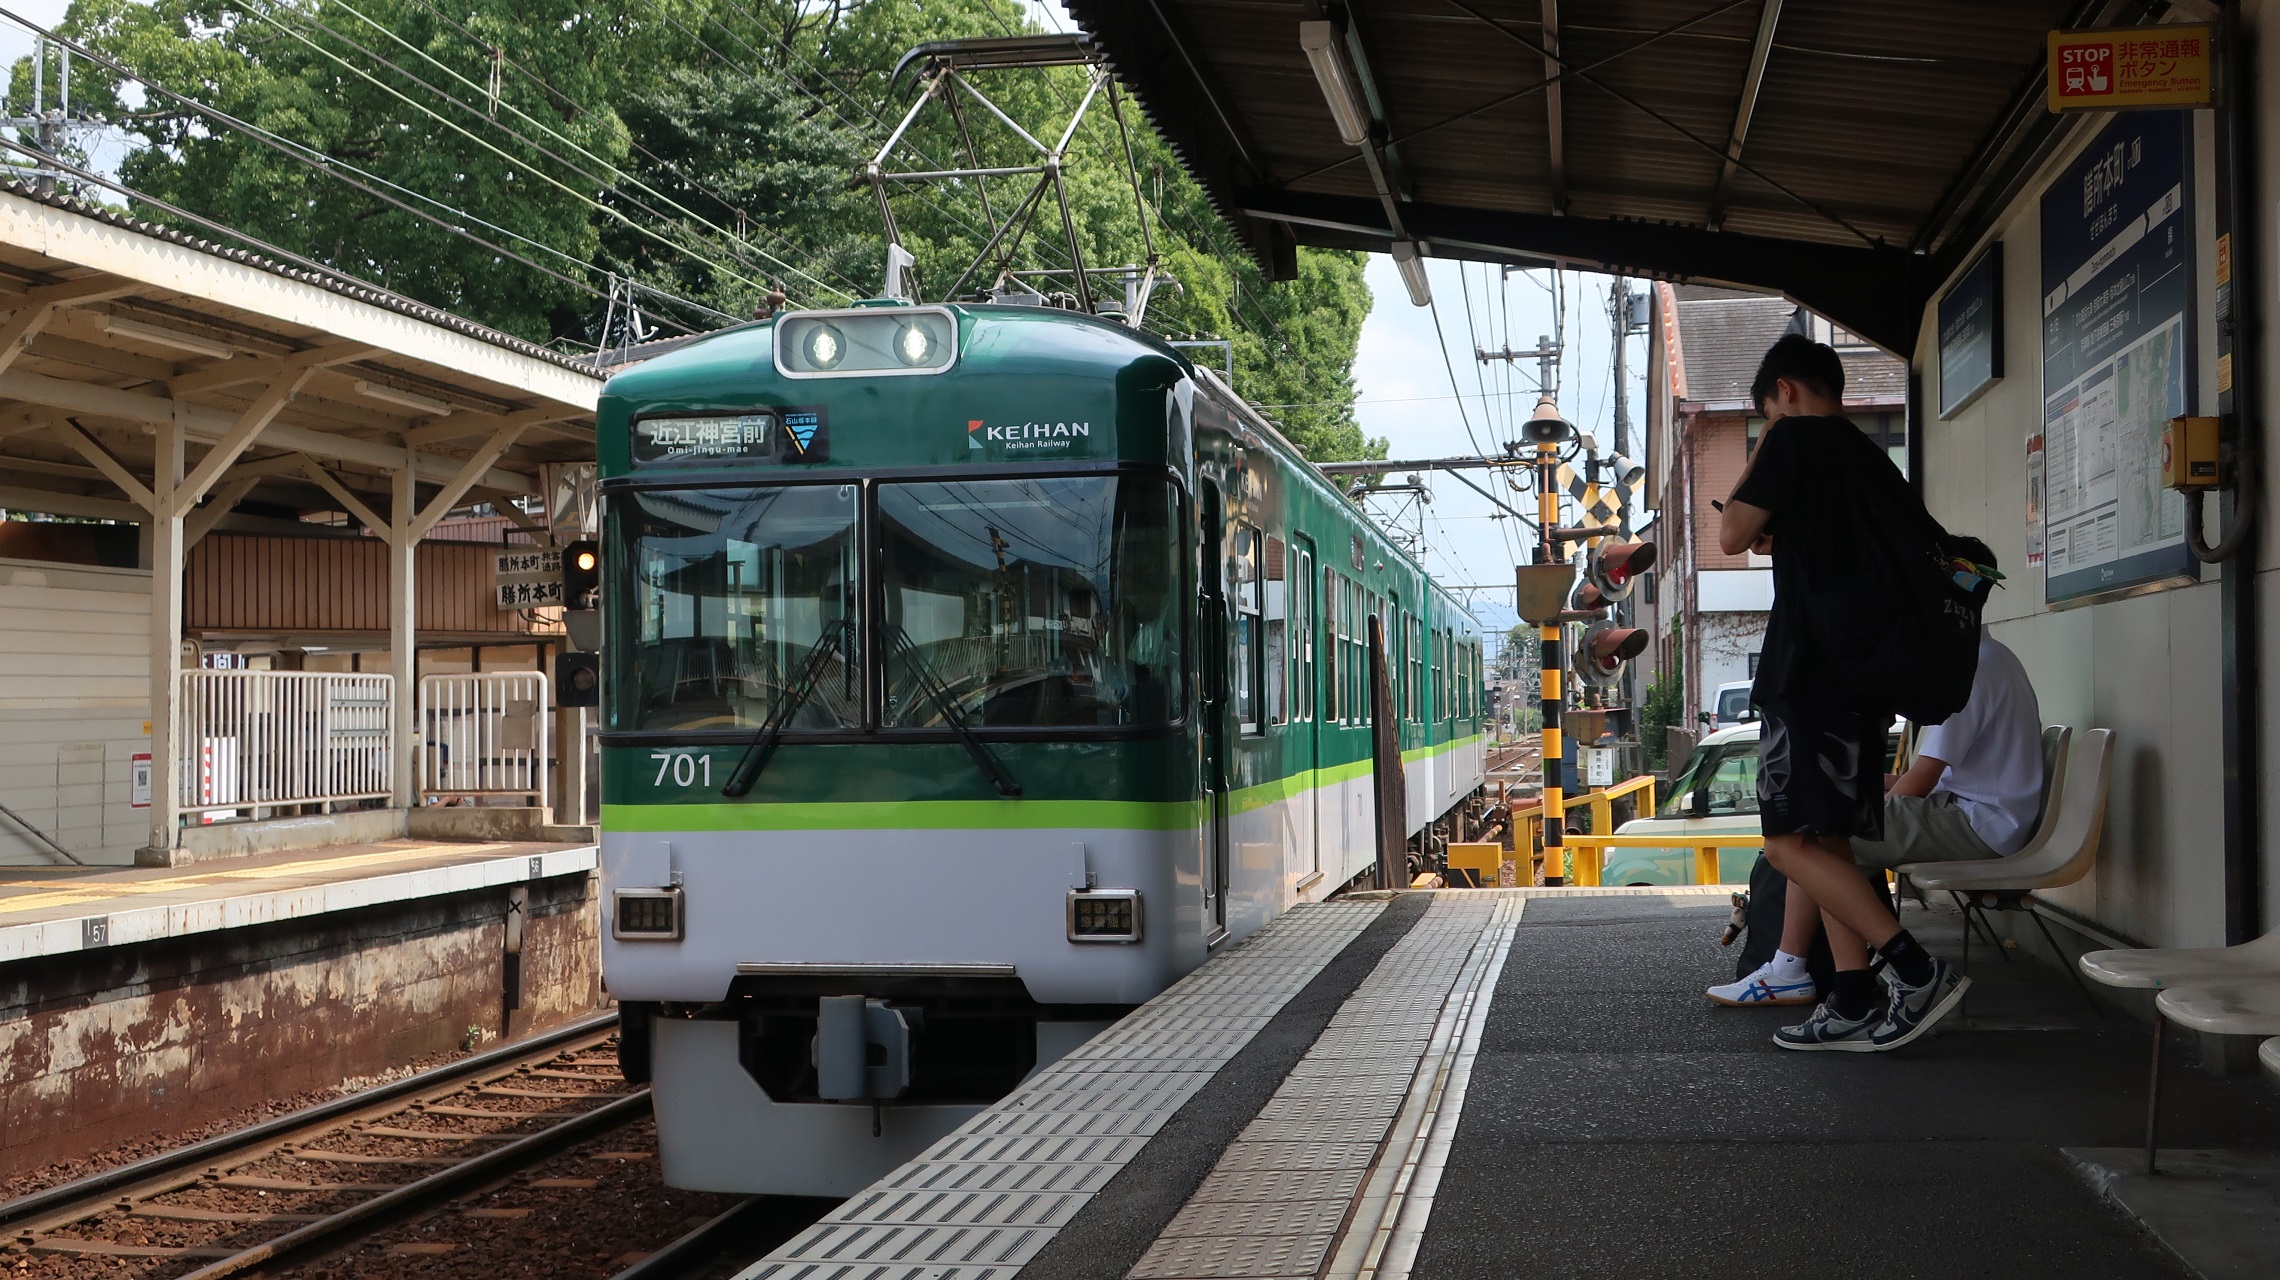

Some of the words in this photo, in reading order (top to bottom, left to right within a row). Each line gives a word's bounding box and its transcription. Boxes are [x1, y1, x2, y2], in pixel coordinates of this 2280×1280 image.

[2062, 48, 2110, 64] STOP
[2118, 38, 2201, 60] 非常通報
[2119, 60, 2177, 79] ボタン
[2119, 79, 2169, 88] Emergency
[2170, 77, 2201, 86] Button
[2083, 140, 2125, 219] 膳所本町
[650, 420, 765, 446] 近江神宮前
[987, 421, 1089, 440] KEIHAN
[1005, 441, 1035, 449] Keihan
[1037, 439, 1071, 448] Railway
[498, 553, 540, 572] 膳所本町
[501, 581, 563, 605] 膳所本町
[650, 753, 710, 787] 701
[93, 924, 106, 943] 57
